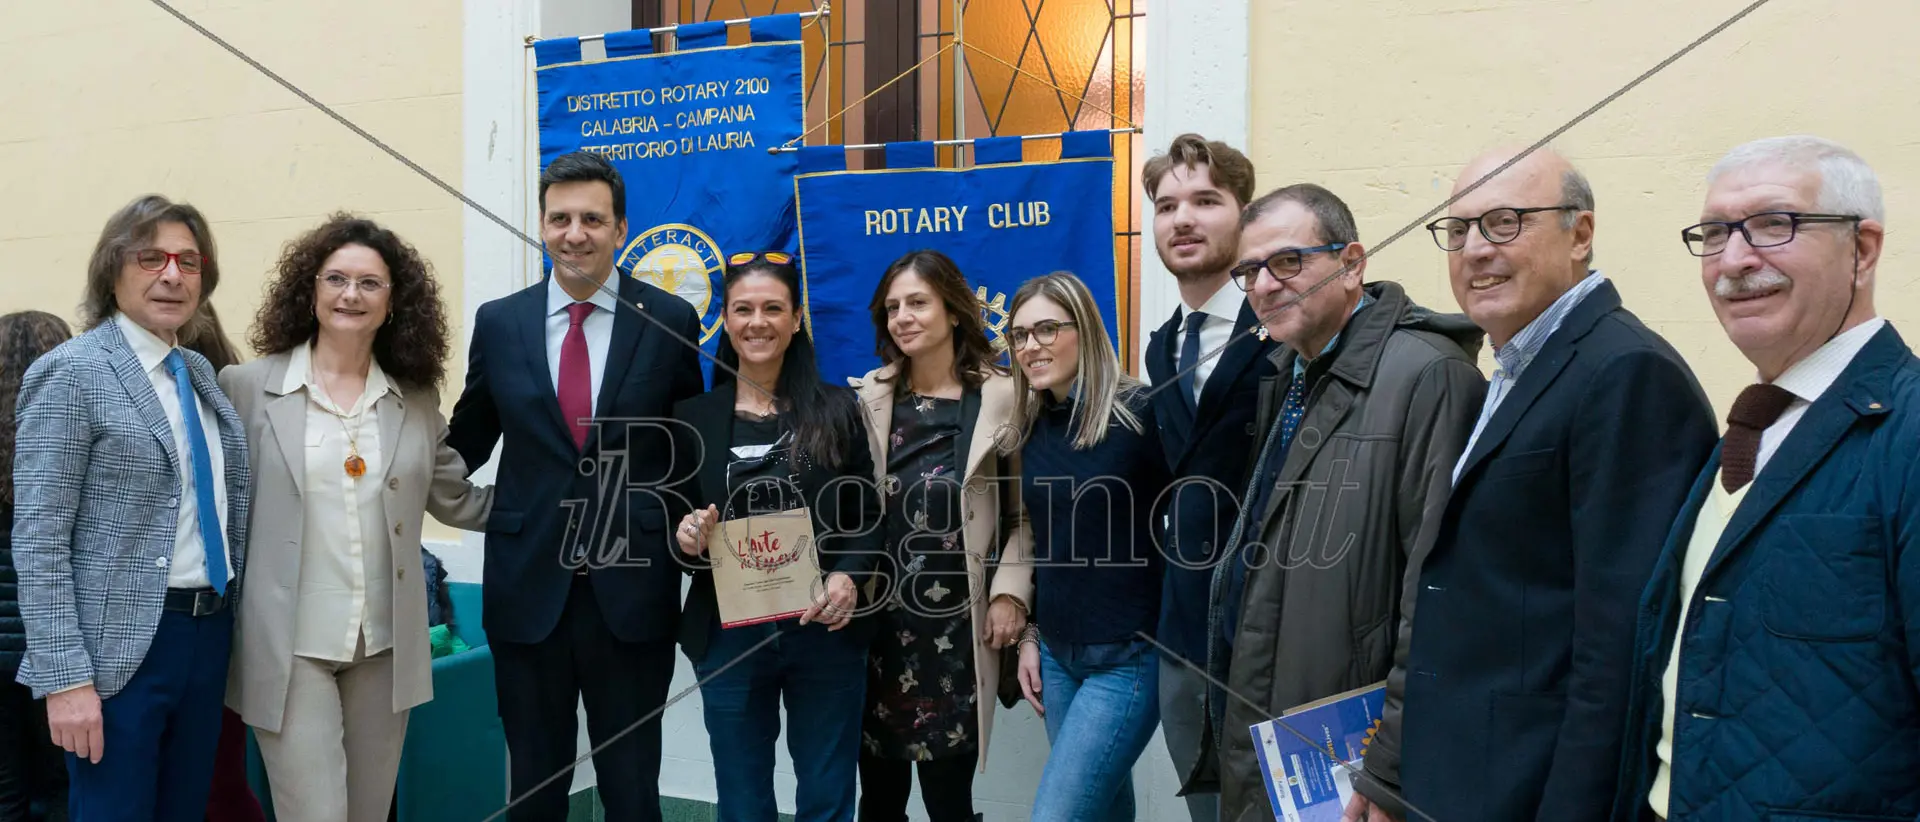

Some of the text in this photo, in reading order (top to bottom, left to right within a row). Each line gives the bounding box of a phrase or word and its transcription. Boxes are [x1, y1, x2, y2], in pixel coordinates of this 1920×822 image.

[567, 77, 770, 113] DISTRETTO ROTARY 2100
[581, 115, 659, 137] CALABRIA
[676, 104, 755, 128] CAMPANIA
[681, 137, 694, 154] DI
[697, 131, 755, 151] LAURIA
[865, 201, 1051, 235] ROTARY CLUB
[622, 230, 716, 271] INTERACT
